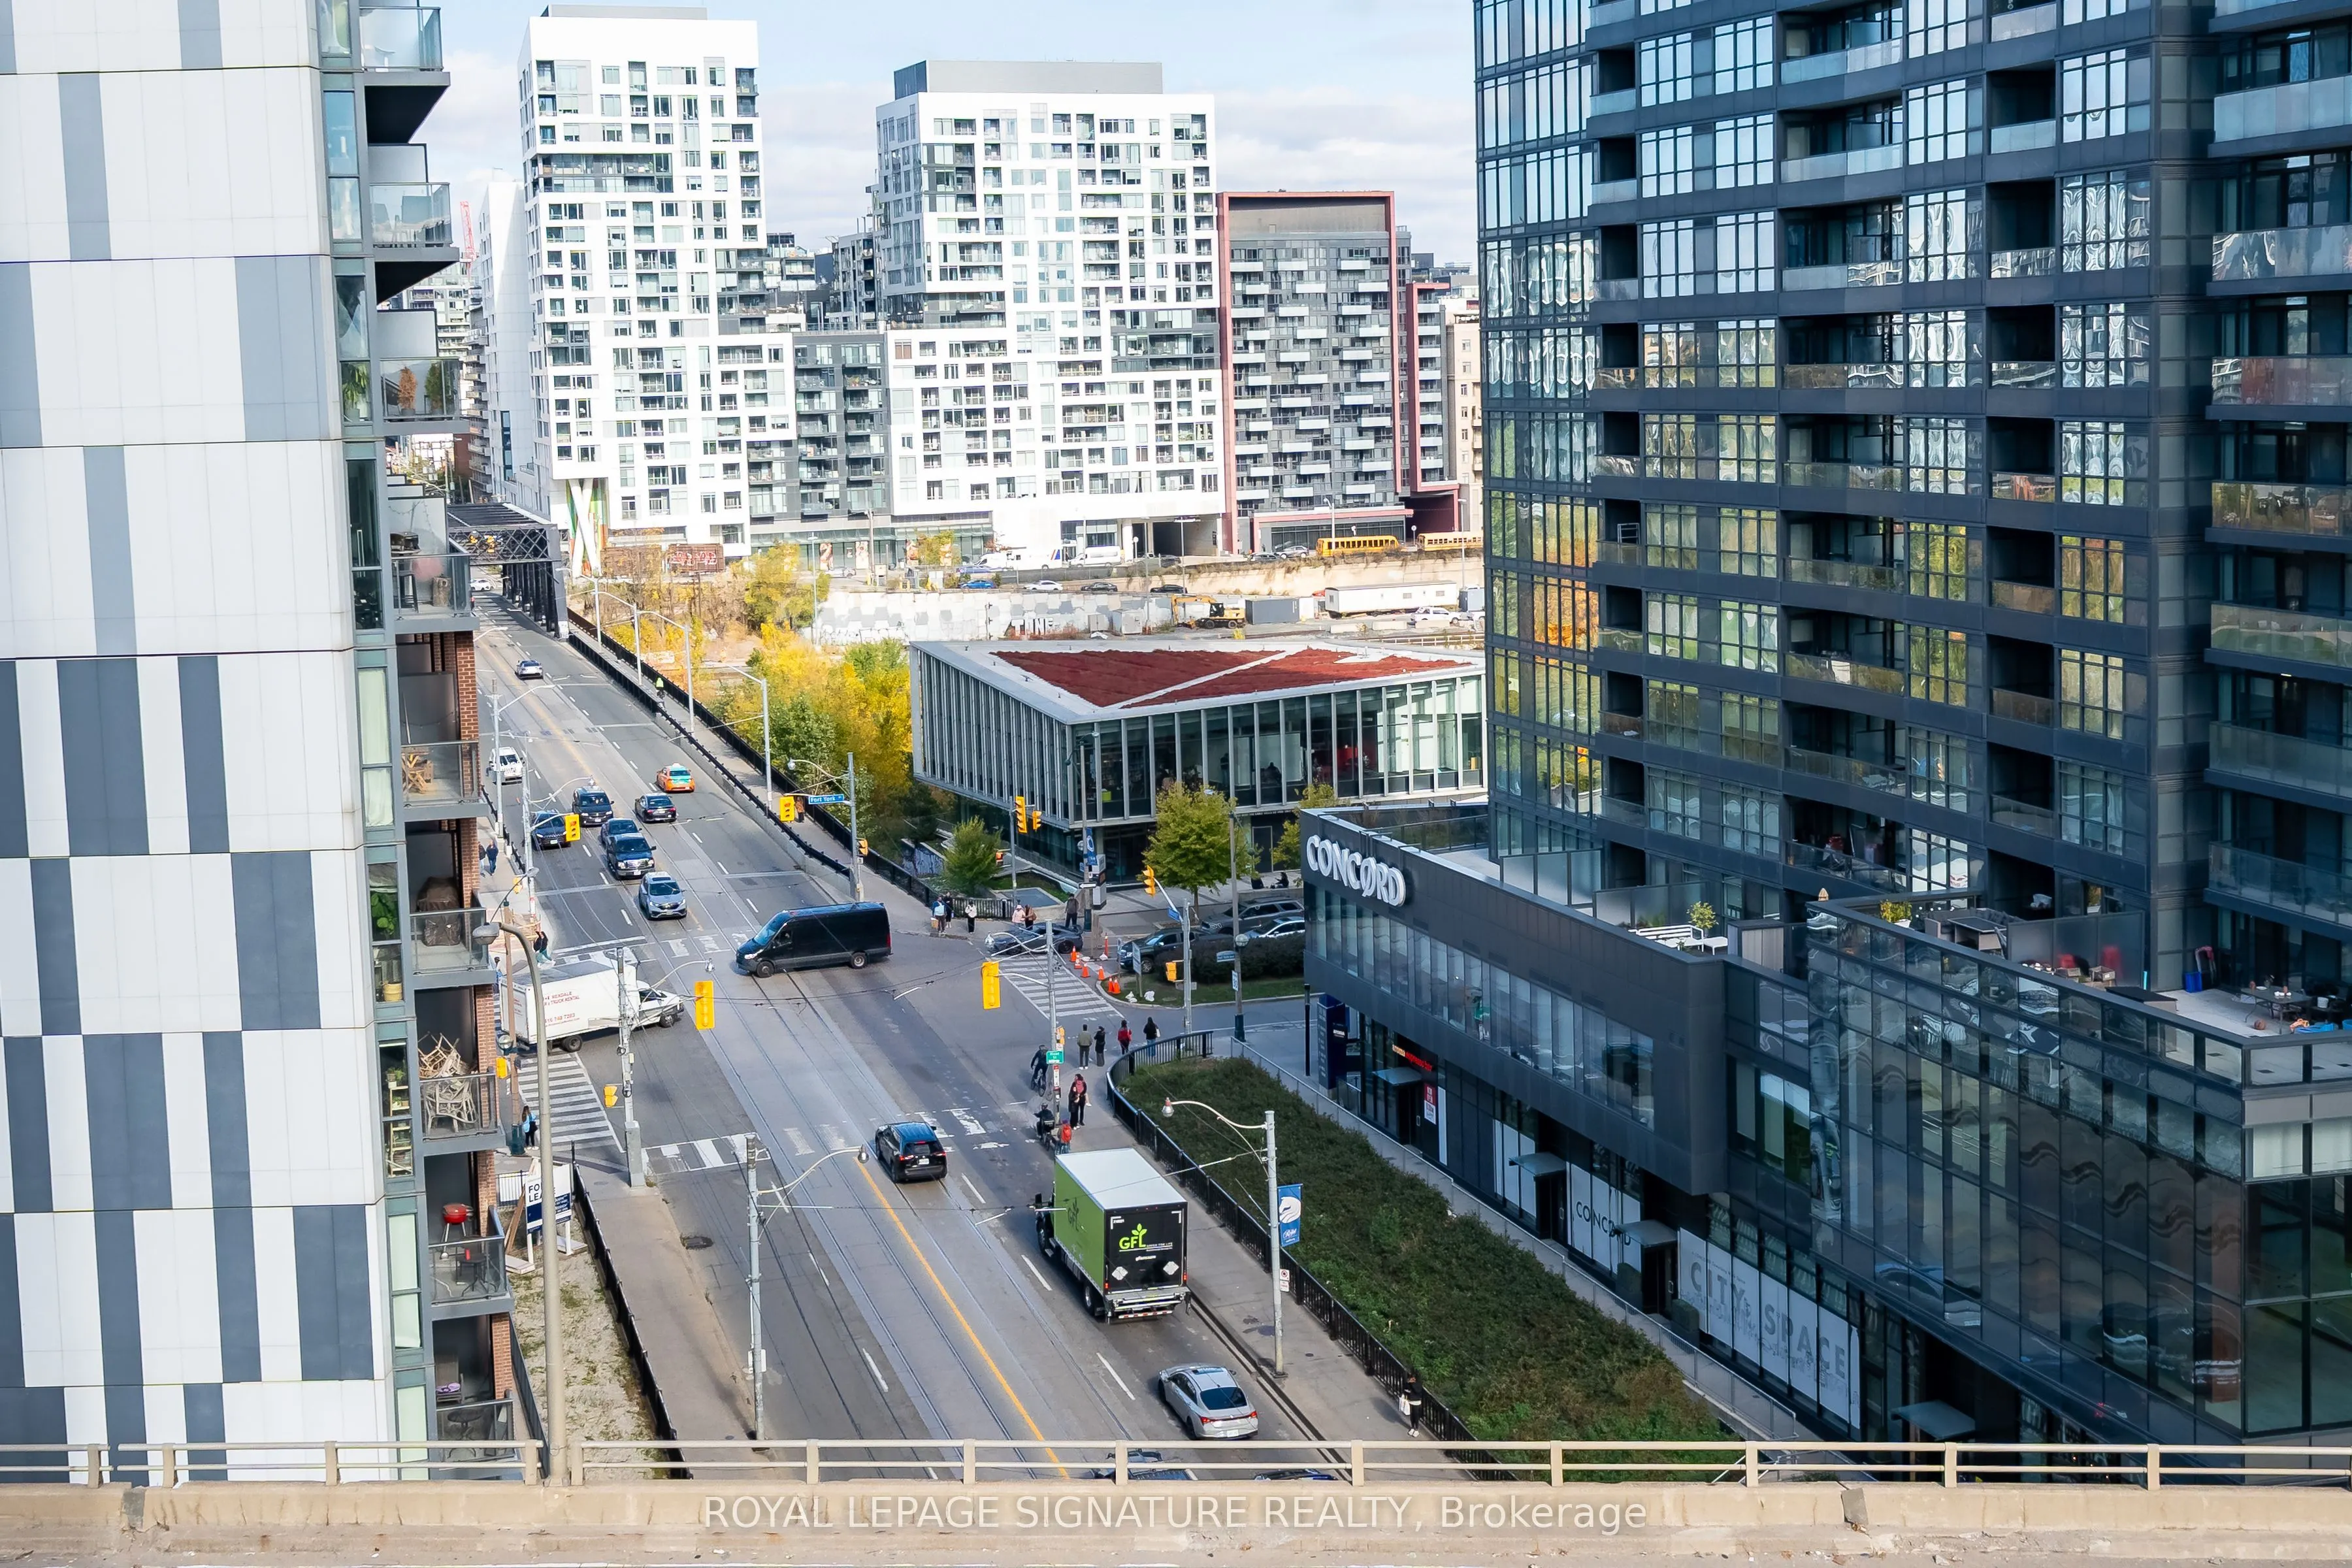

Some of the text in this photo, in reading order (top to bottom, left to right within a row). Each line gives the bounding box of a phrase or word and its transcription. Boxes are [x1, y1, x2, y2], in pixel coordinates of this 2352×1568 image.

[1119, 1228, 1147, 1249] GFL
[1691, 1262, 1745, 1313] CITY
[1765, 1304, 1845, 1379] SPACE
